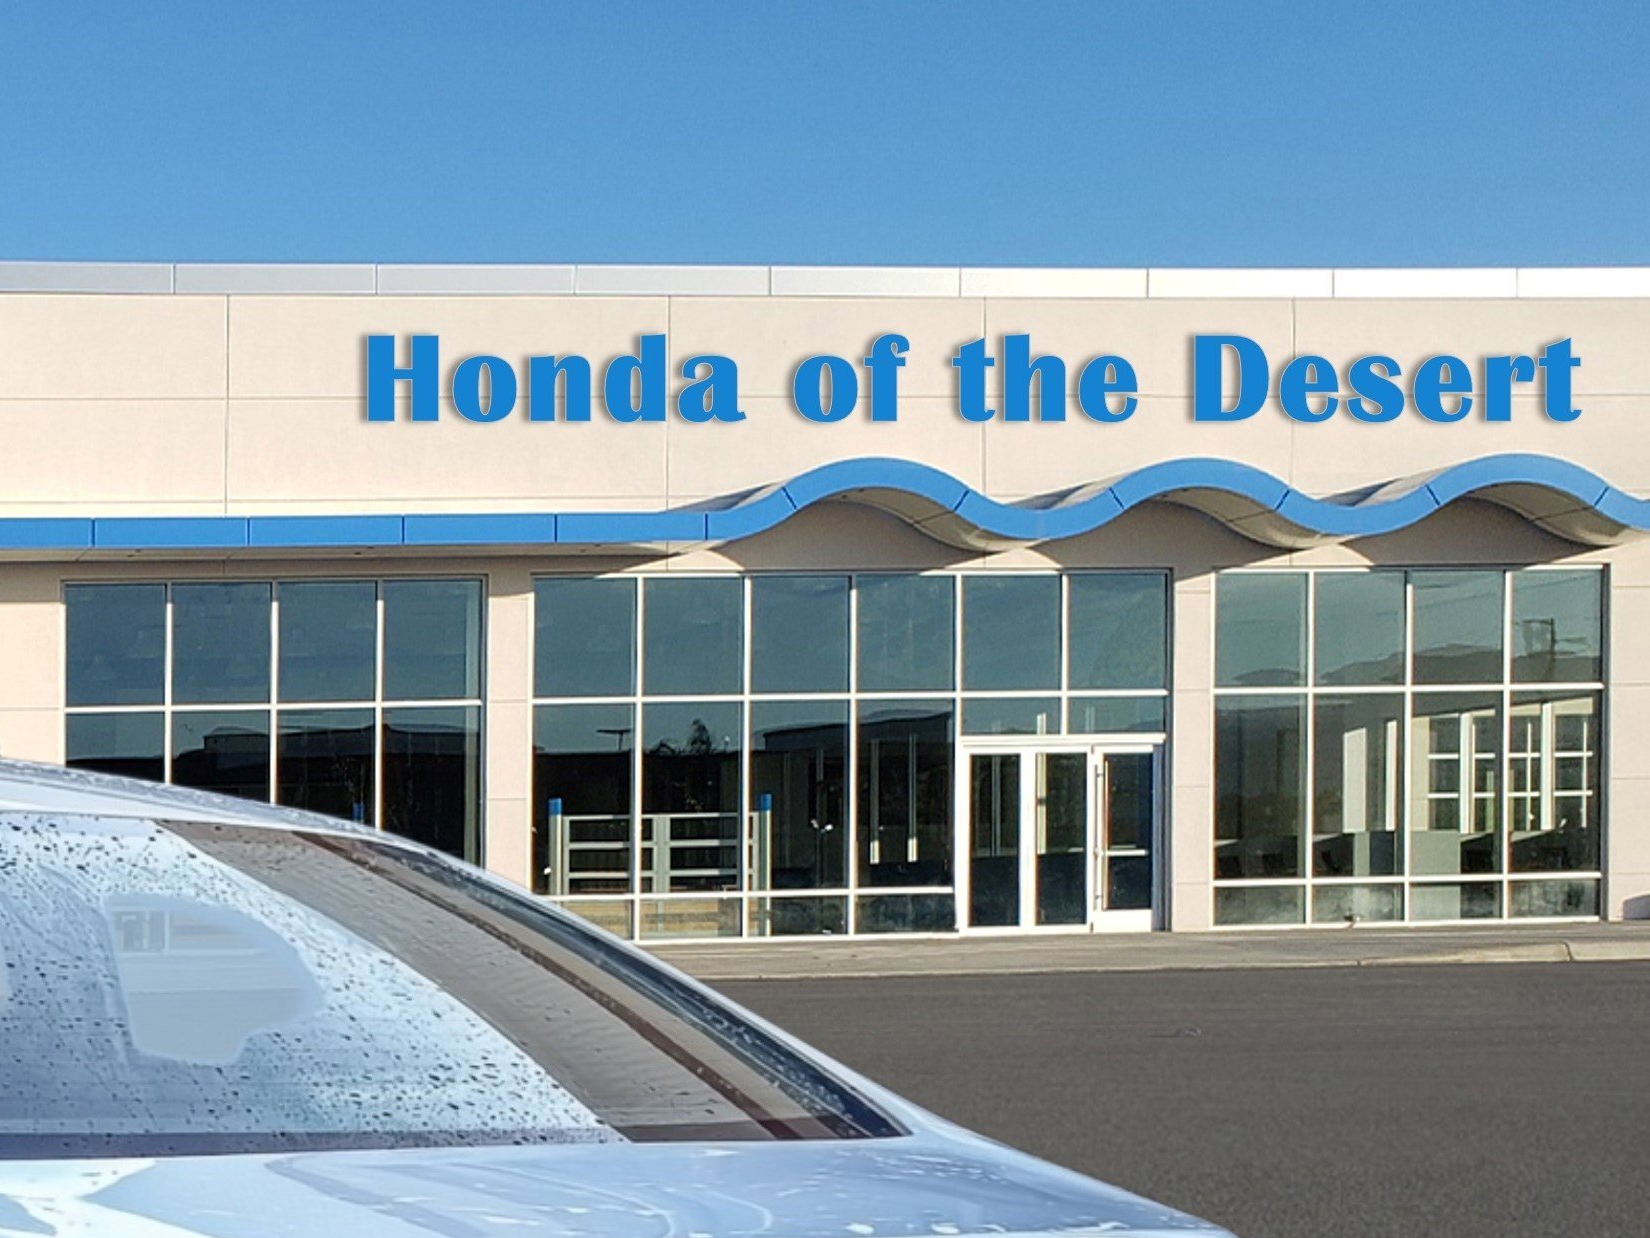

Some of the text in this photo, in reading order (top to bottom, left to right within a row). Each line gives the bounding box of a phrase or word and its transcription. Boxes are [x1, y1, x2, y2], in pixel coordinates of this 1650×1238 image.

[366, 333, 1582, 423] Honda of the Desert
